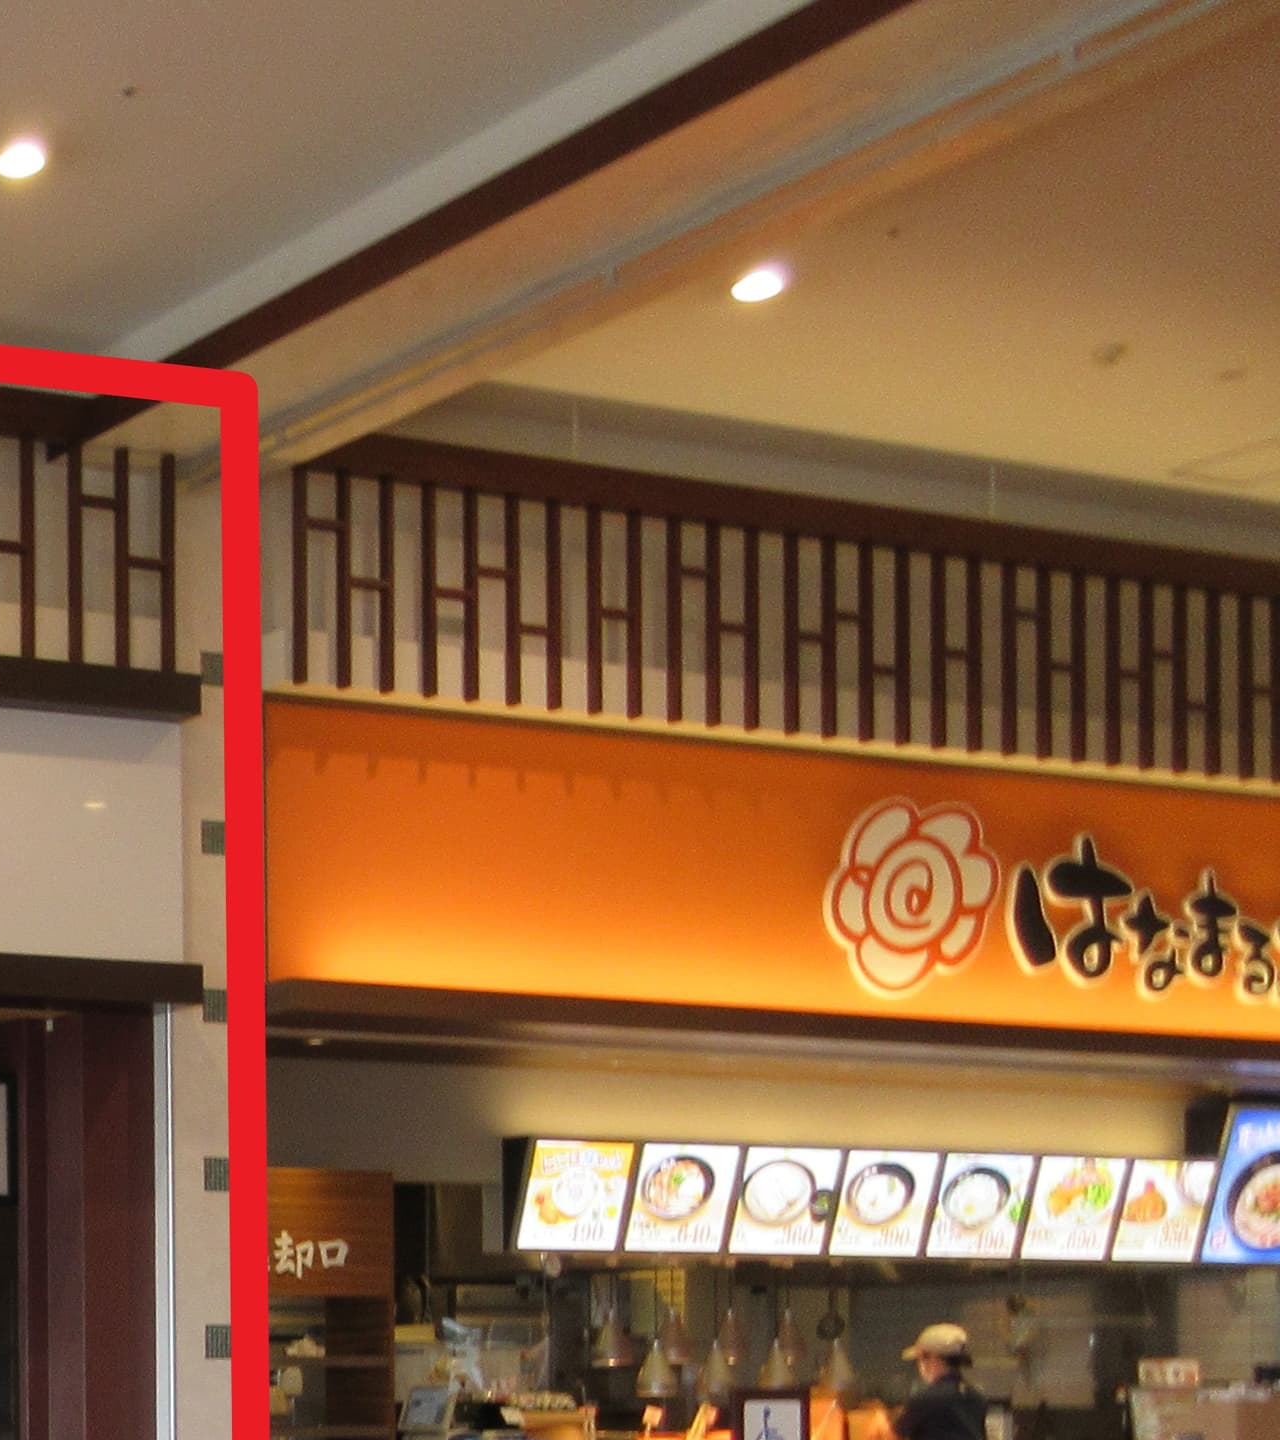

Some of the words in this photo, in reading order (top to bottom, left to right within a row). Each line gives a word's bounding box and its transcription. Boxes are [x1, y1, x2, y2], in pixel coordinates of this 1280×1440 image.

[1007, 832, 1280, 1000] はなまる
[267, 1229, 348, 1279] 却口
